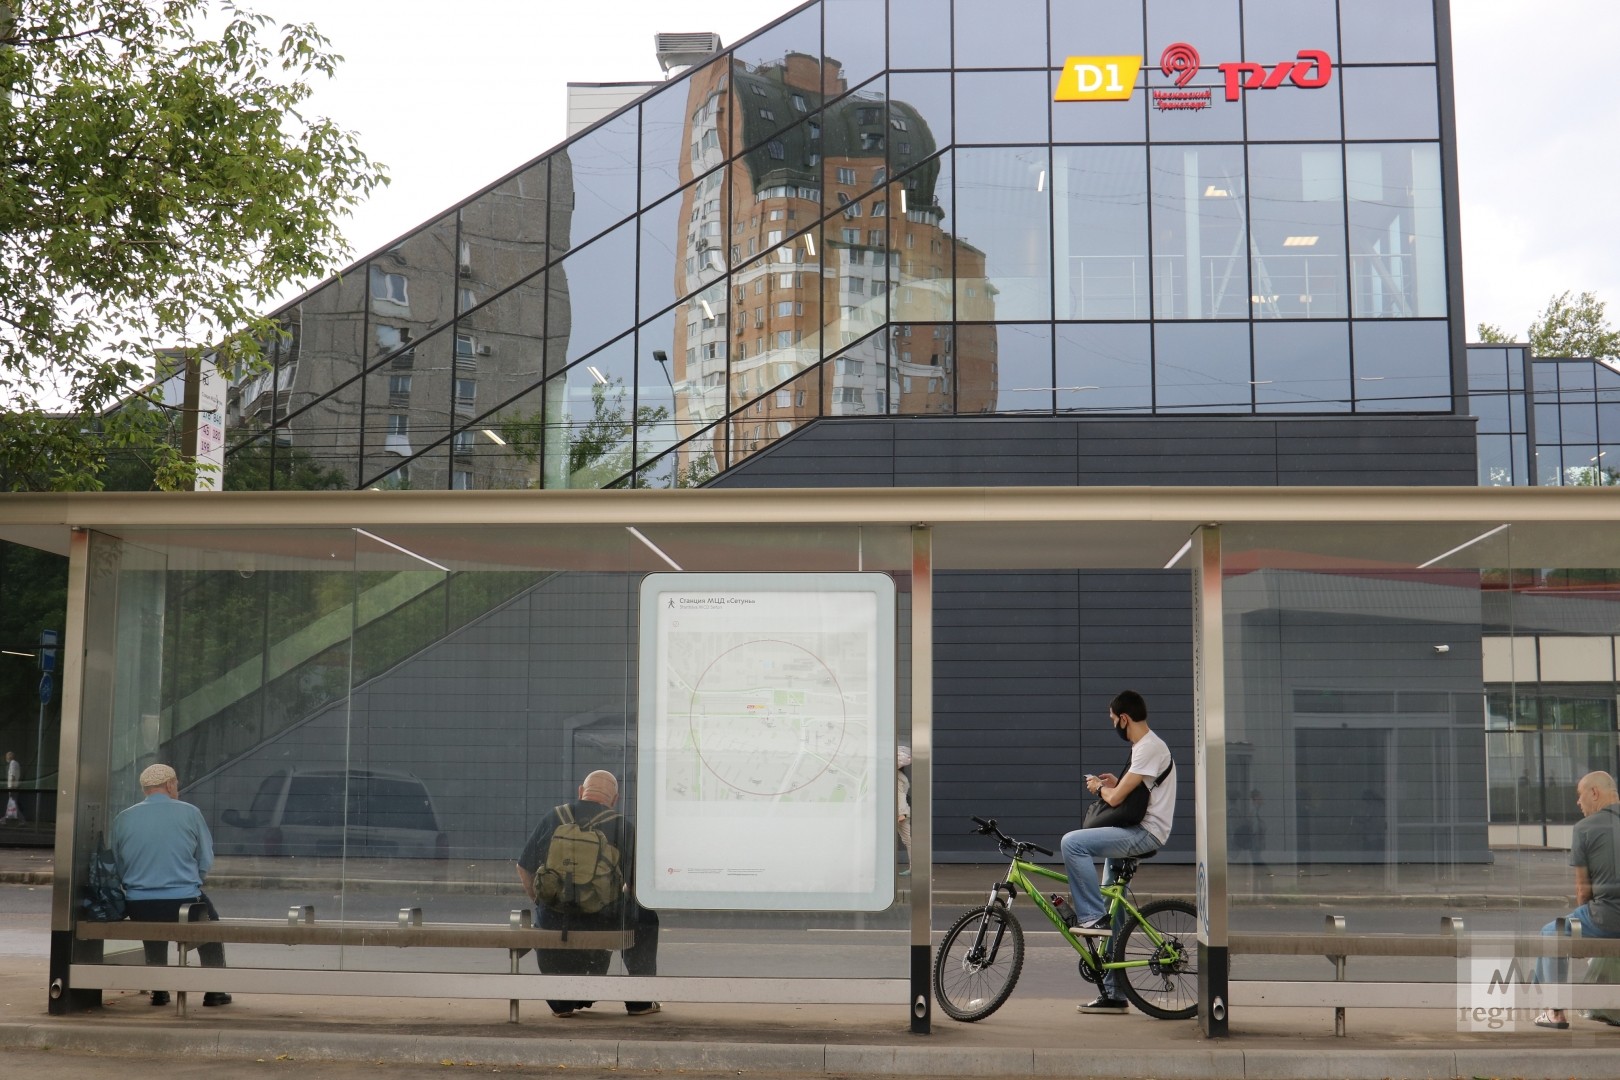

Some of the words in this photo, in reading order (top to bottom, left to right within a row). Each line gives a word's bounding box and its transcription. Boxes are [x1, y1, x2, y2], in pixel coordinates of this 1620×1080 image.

[1074, 64, 1124, 92] D1
[679, 597, 706, 605] Станция
[707, 597, 725, 605] МЦД
